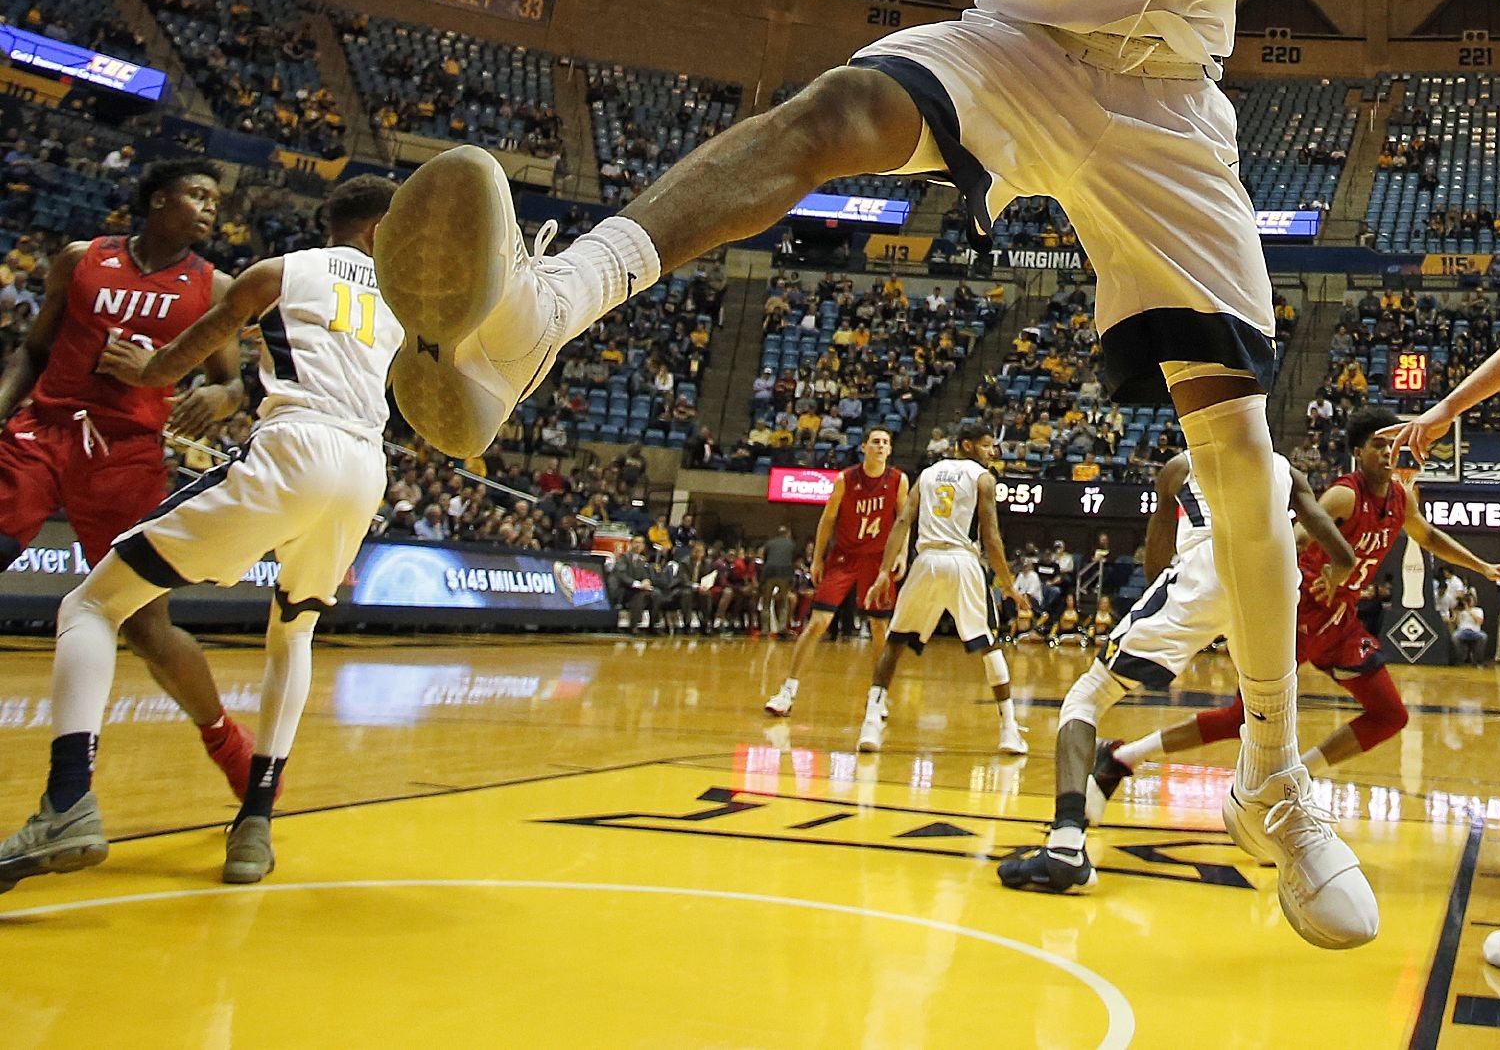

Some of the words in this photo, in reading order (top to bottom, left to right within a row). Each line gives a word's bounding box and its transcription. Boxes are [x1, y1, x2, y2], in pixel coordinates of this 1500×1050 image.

[866, 6, 901, 28] 218
[1261, 45, 1302, 65] 220
[1457, 47, 1493, 67] 221
[1008, 250, 1081, 269] VIRGINIA
[328, 257, 379, 288] HUNTE
[92, 287, 180, 324] NJIT
[329, 281, 377, 349] 11
[1394, 368, 1423, 391] 20
[781, 475, 834, 496] Fronti
[995, 483, 1043, 503] 9:51
[855, 497, 886, 516] NJIT
[932, 484, 956, 519] 3
[1080, 493, 1105, 514] 17
[857, 516, 882, 540] 14
[446, 567, 488, 592] $145
[489, 570, 556, 594] MILLION
